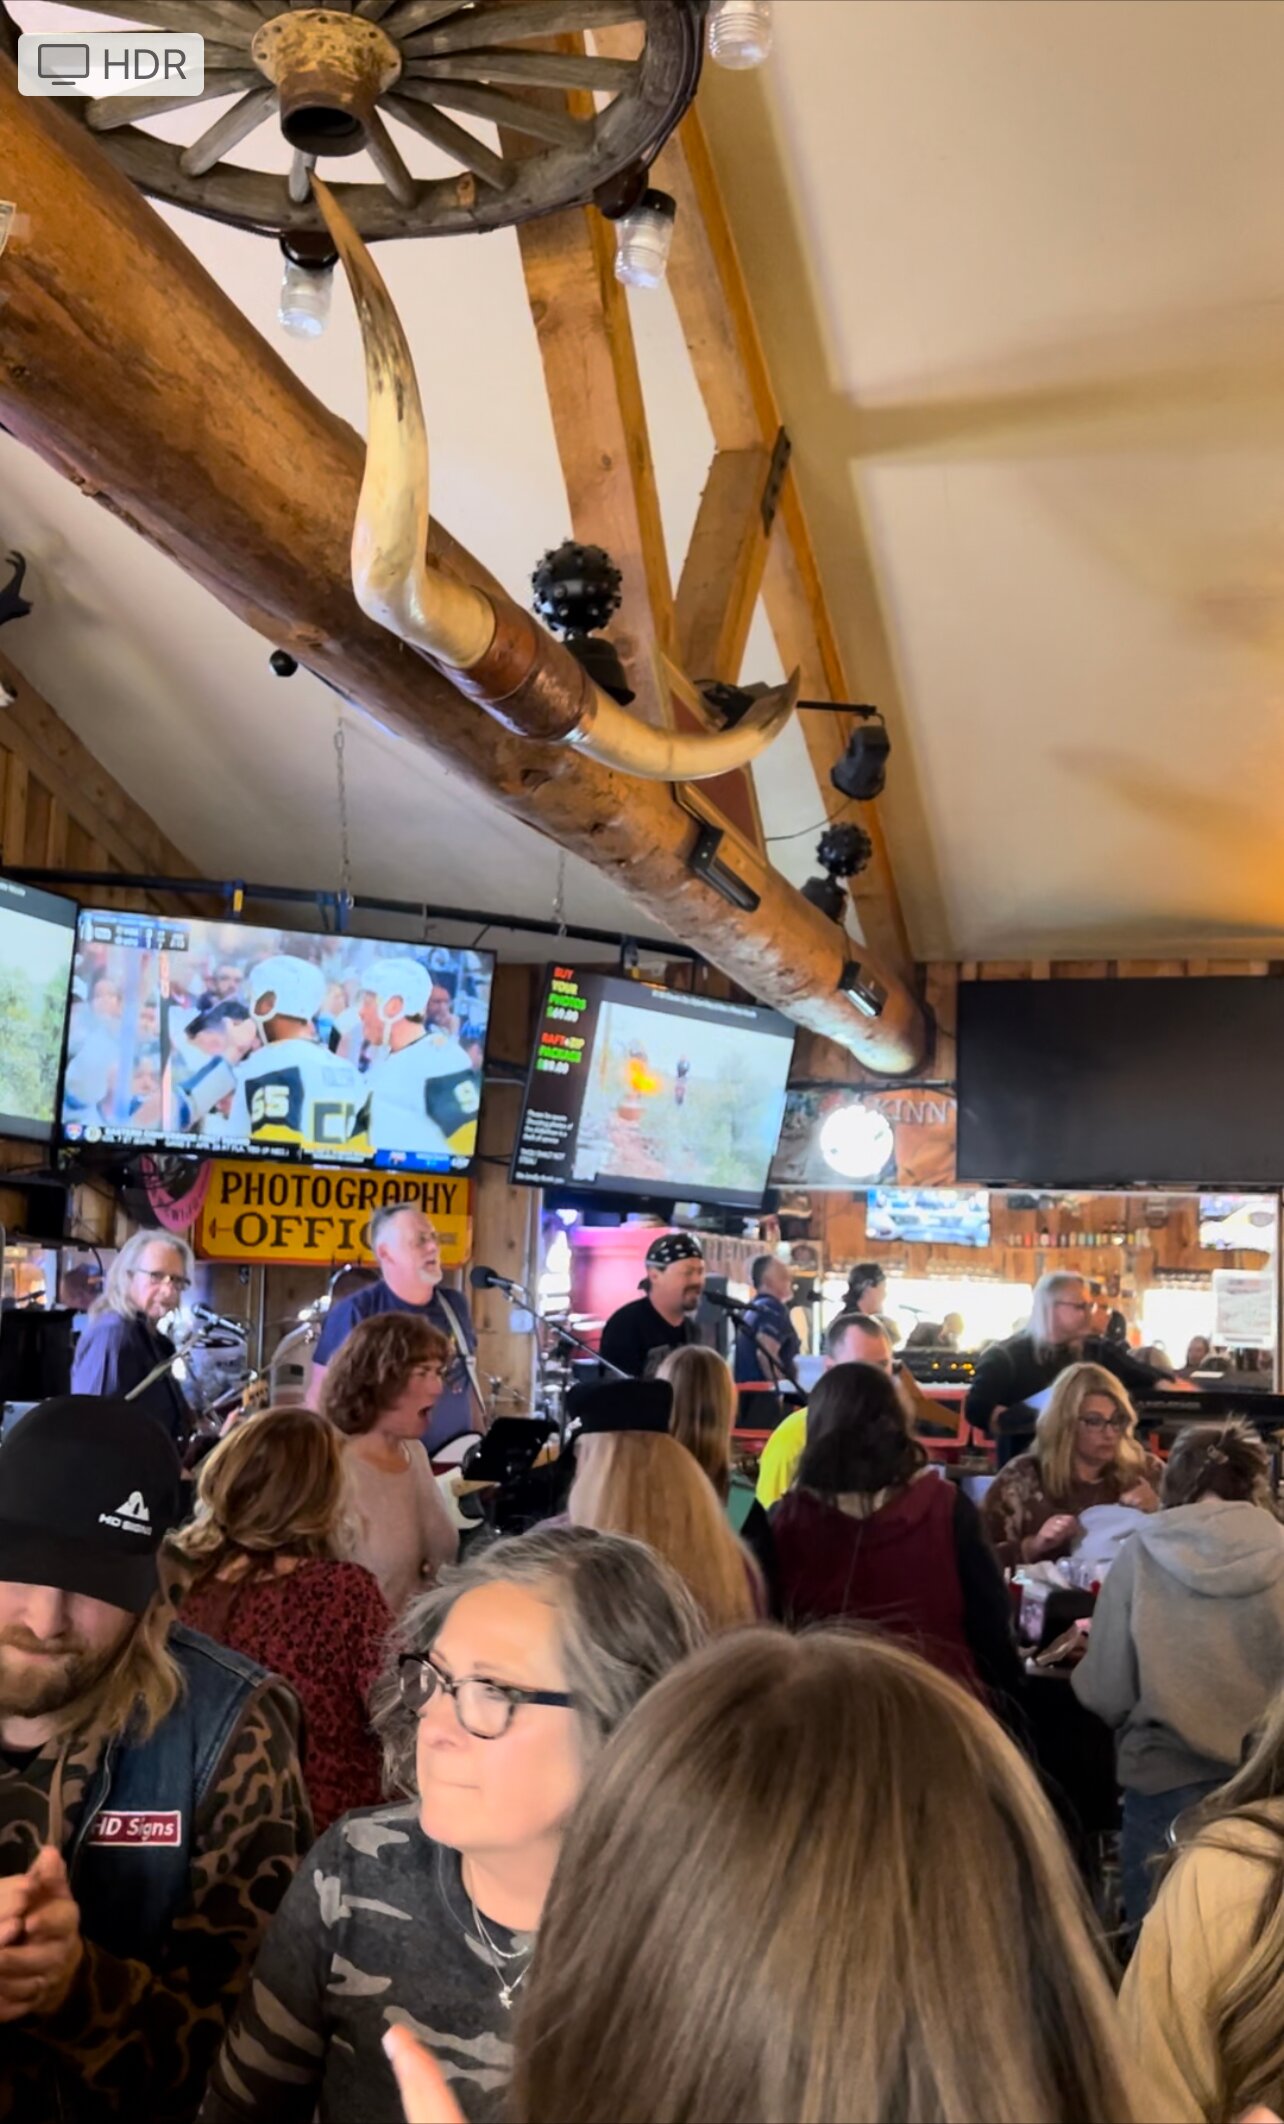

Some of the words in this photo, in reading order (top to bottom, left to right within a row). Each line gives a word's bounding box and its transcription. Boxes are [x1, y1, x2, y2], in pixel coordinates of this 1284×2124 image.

[878, 1097, 957, 1124] KINN
[220, 1170, 458, 1215] PHOTOGRAPHY
[98, 1513, 122, 1528] HD
[126, 1815, 175, 1842] Signs
